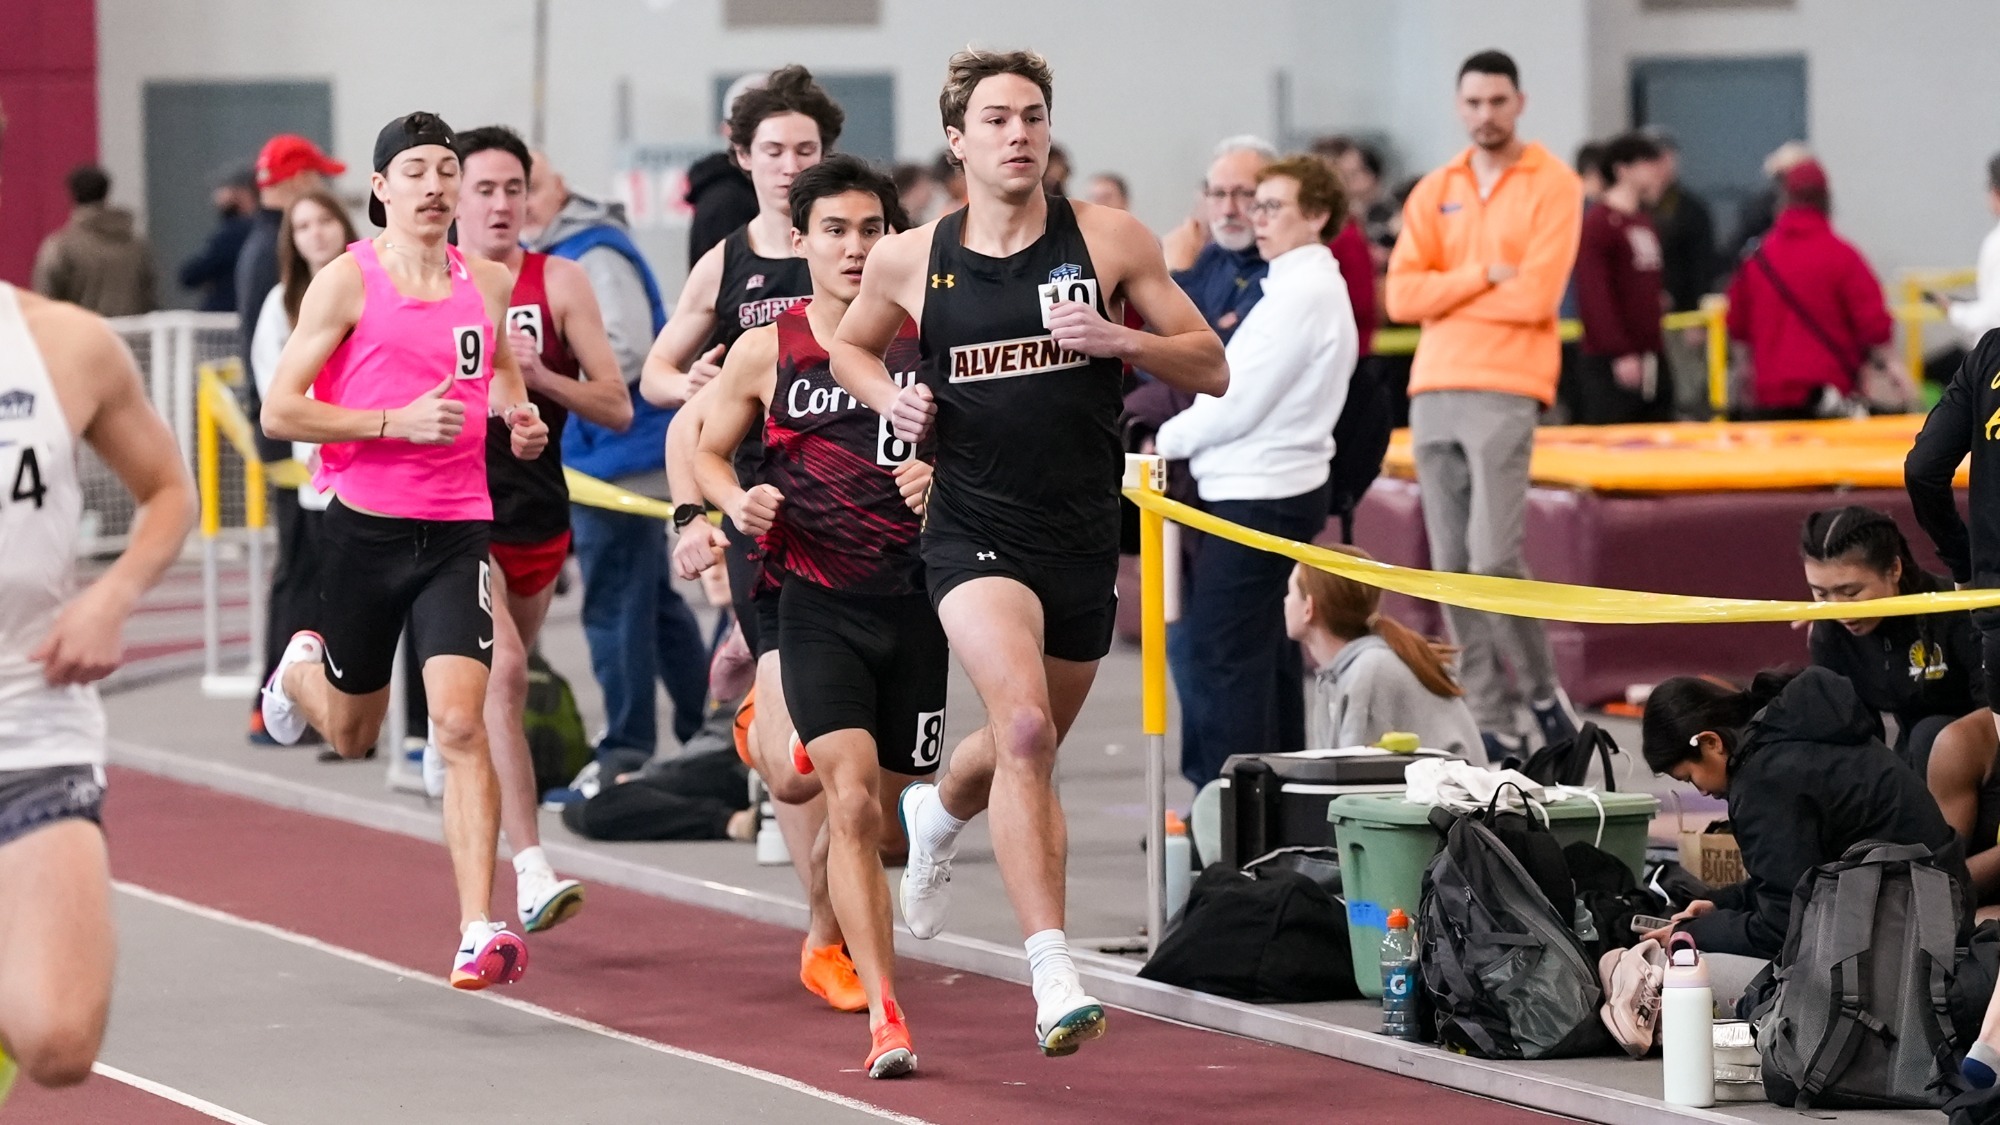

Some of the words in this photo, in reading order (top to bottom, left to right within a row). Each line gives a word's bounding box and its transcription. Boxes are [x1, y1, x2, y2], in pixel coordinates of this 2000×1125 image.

[460, 330, 481, 375] 9
[955, 338, 1086, 378] ALVERNIA
[883, 420, 912, 462] 8
[0, 446, 47, 509] 4
[921, 715, 942, 762] 8
[1390, 974, 1407, 995] G
